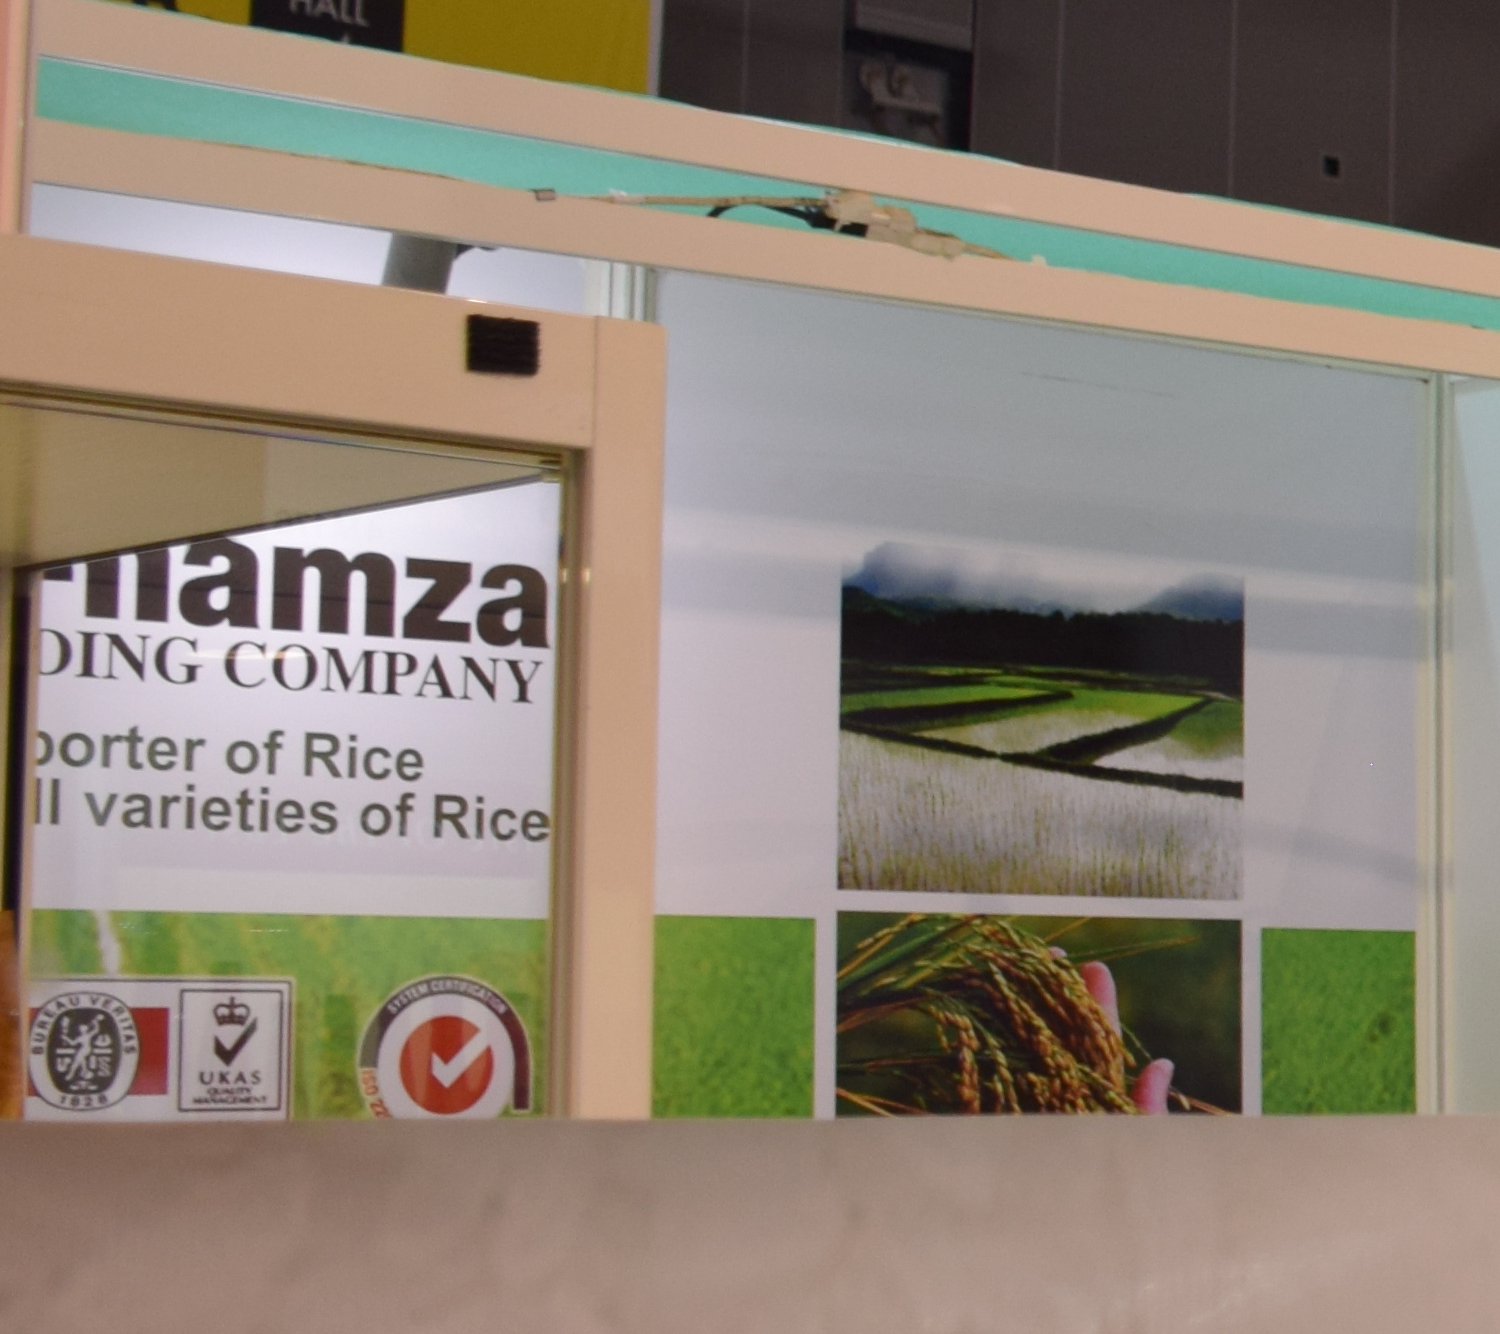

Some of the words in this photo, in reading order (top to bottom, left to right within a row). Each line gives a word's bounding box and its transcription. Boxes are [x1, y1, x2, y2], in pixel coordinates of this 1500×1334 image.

[224, 639, 544, 704] COMPANY
[225, 729, 285, 775] of
[303, 731, 425, 782] Rice
[85, 784, 338, 835] varieties
[359, 792, 415, 838] of
[432, 793, 552, 843] Rice
[31, 995, 81, 1056] BUREAU
[89, 995, 138, 1055] VERITAS
[198, 1071, 263, 1085] UKAS
